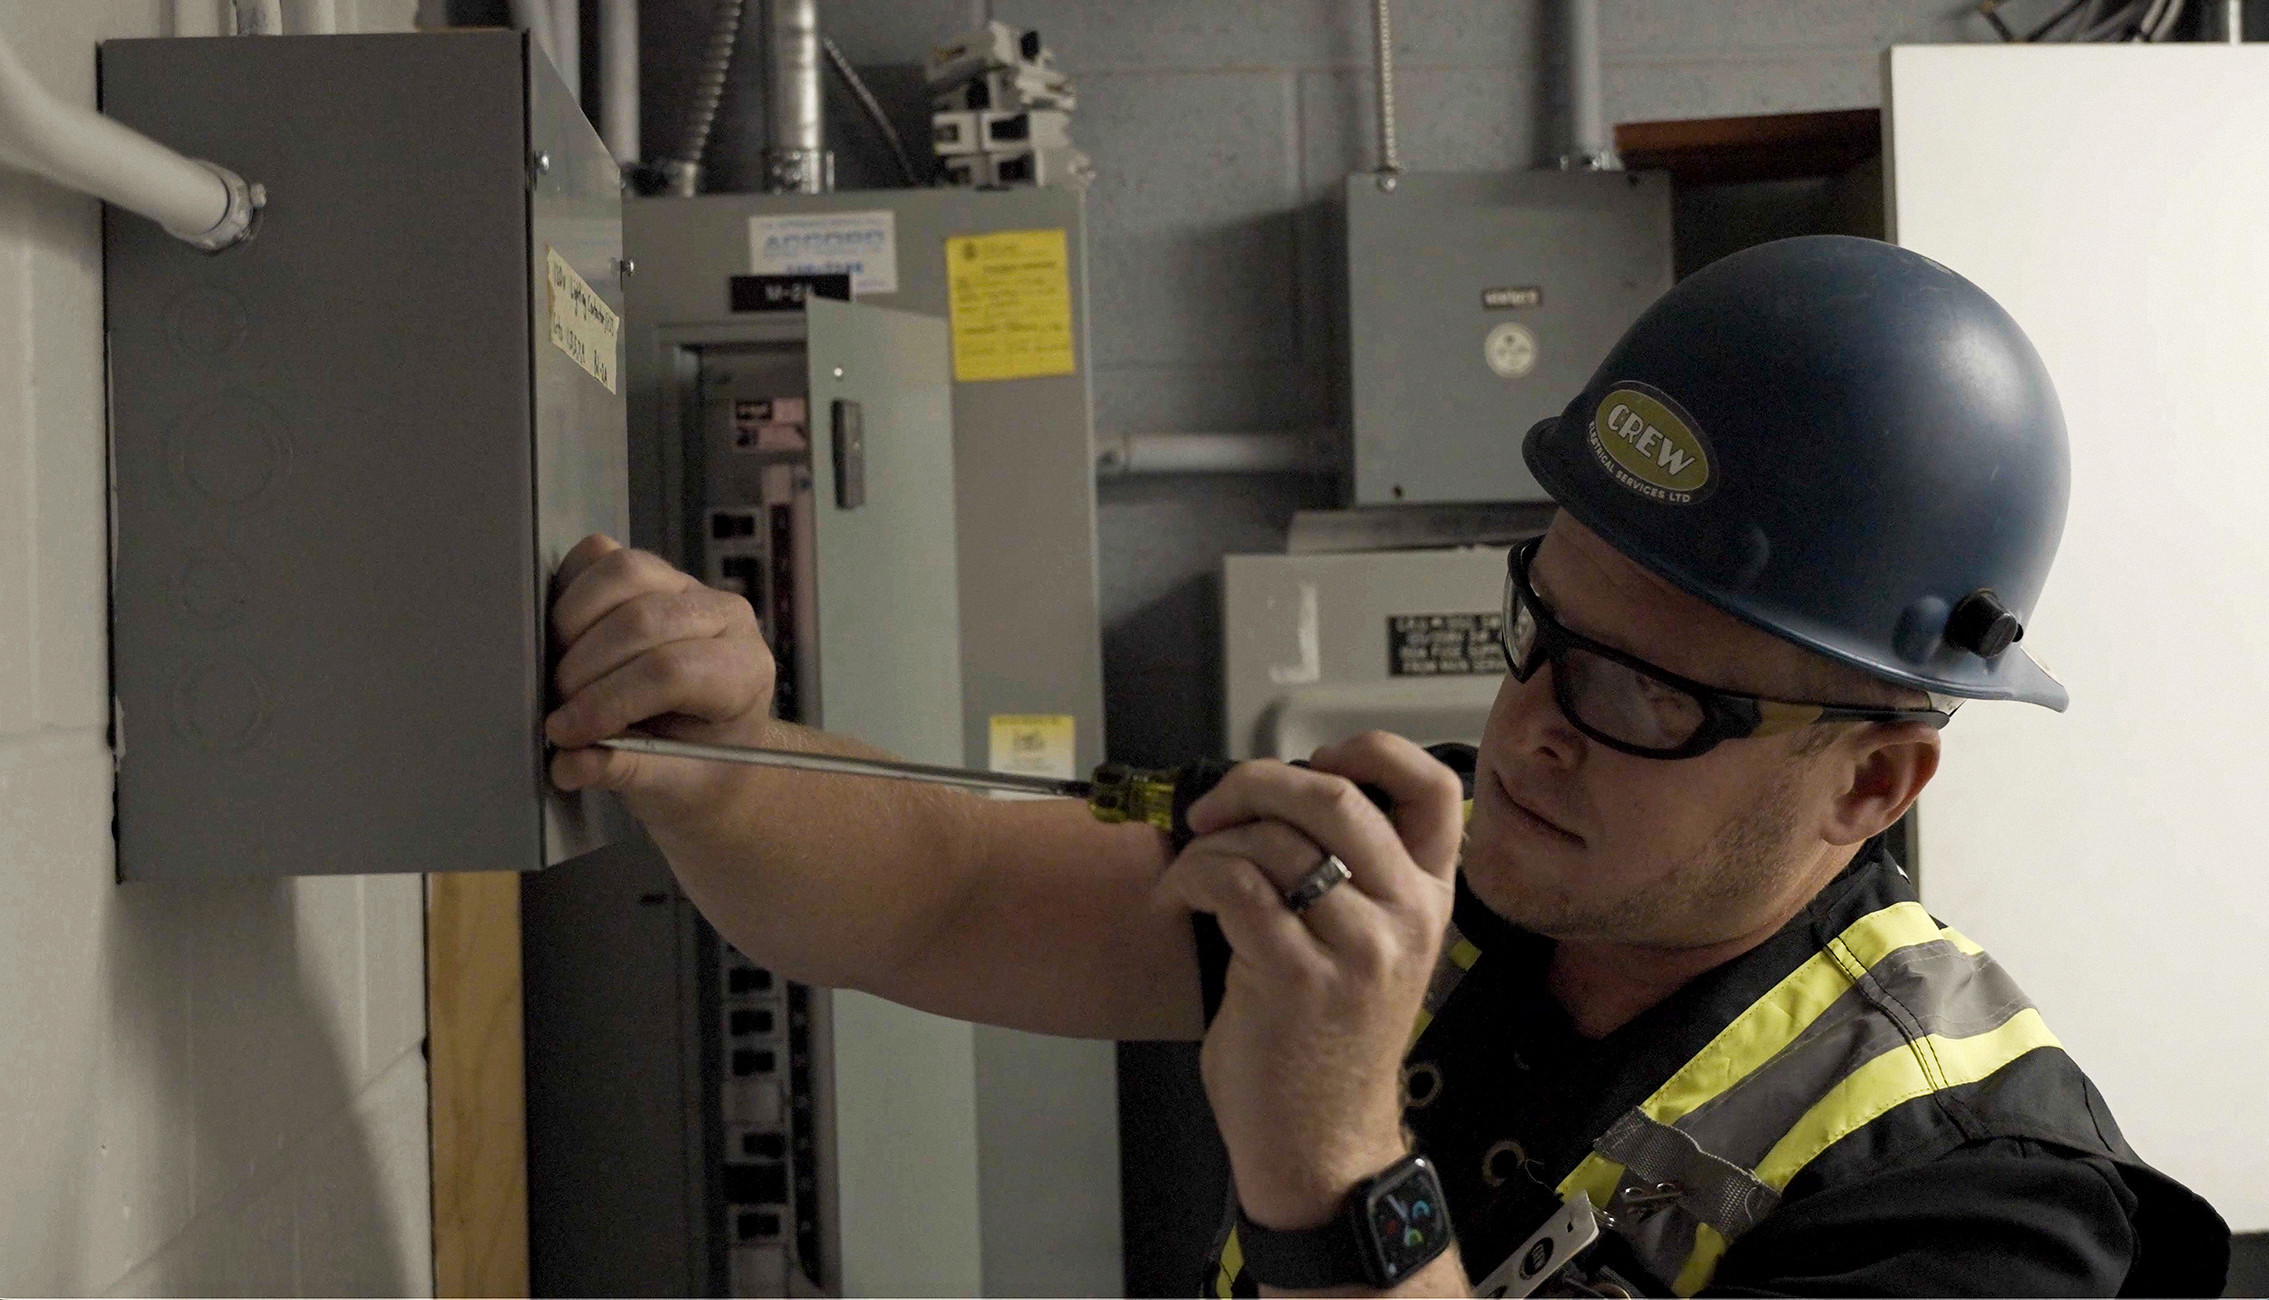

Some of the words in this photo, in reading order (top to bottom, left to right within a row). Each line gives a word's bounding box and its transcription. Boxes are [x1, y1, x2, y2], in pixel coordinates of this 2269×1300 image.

[1588, 420, 1615, 474] ELECTRICAL
[1615, 469, 1666, 500] SERVICES
[1669, 493, 1692, 503] LTD
[1607, 404, 1696, 476] CREW
